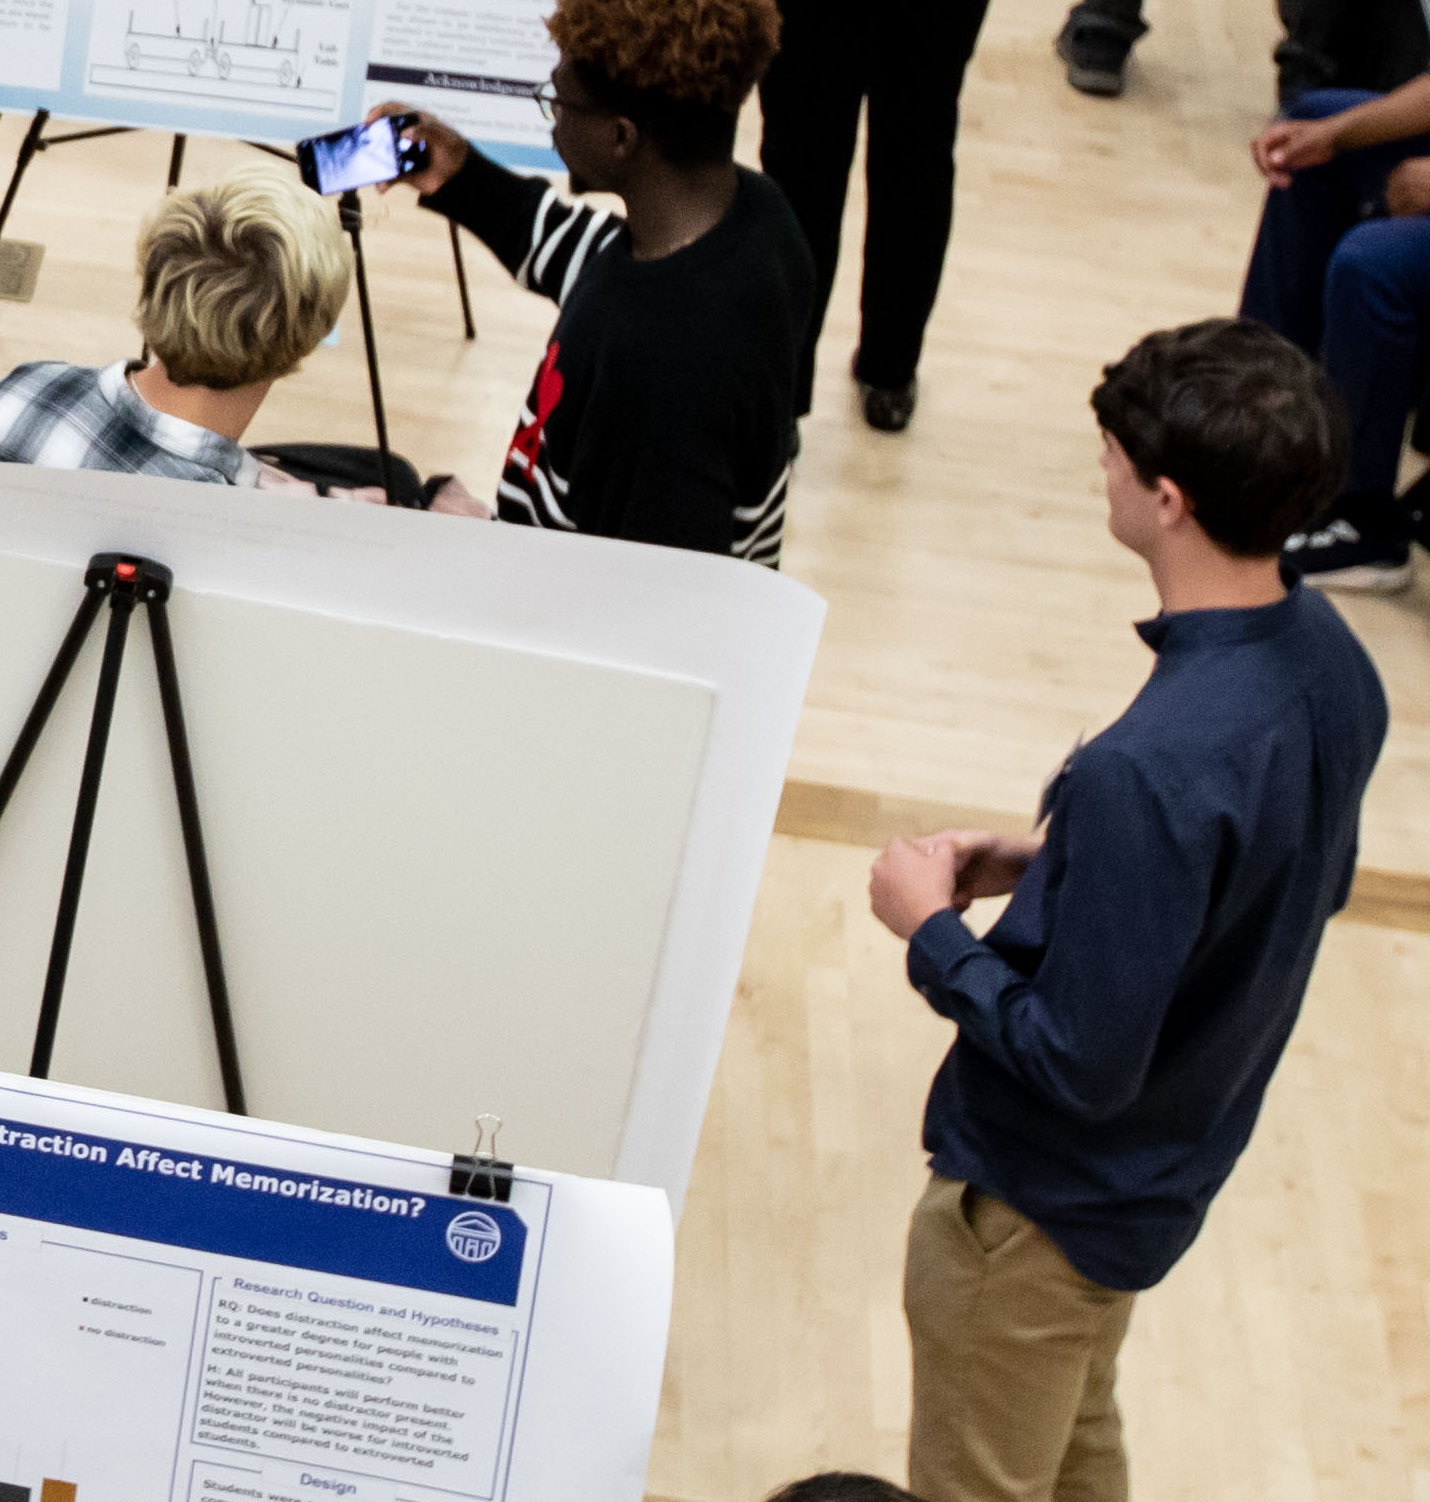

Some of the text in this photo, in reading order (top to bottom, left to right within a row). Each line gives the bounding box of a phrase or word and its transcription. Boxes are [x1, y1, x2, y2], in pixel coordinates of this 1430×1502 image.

[115, 1147, 203, 1180] Affect
[210, 1163, 425, 1217] Memorization?
[91, 1297, 153, 1314] distraction
[233, 1277, 499, 1335] Research Question and Hypotheses
[299, 1472, 356, 1495] Design
